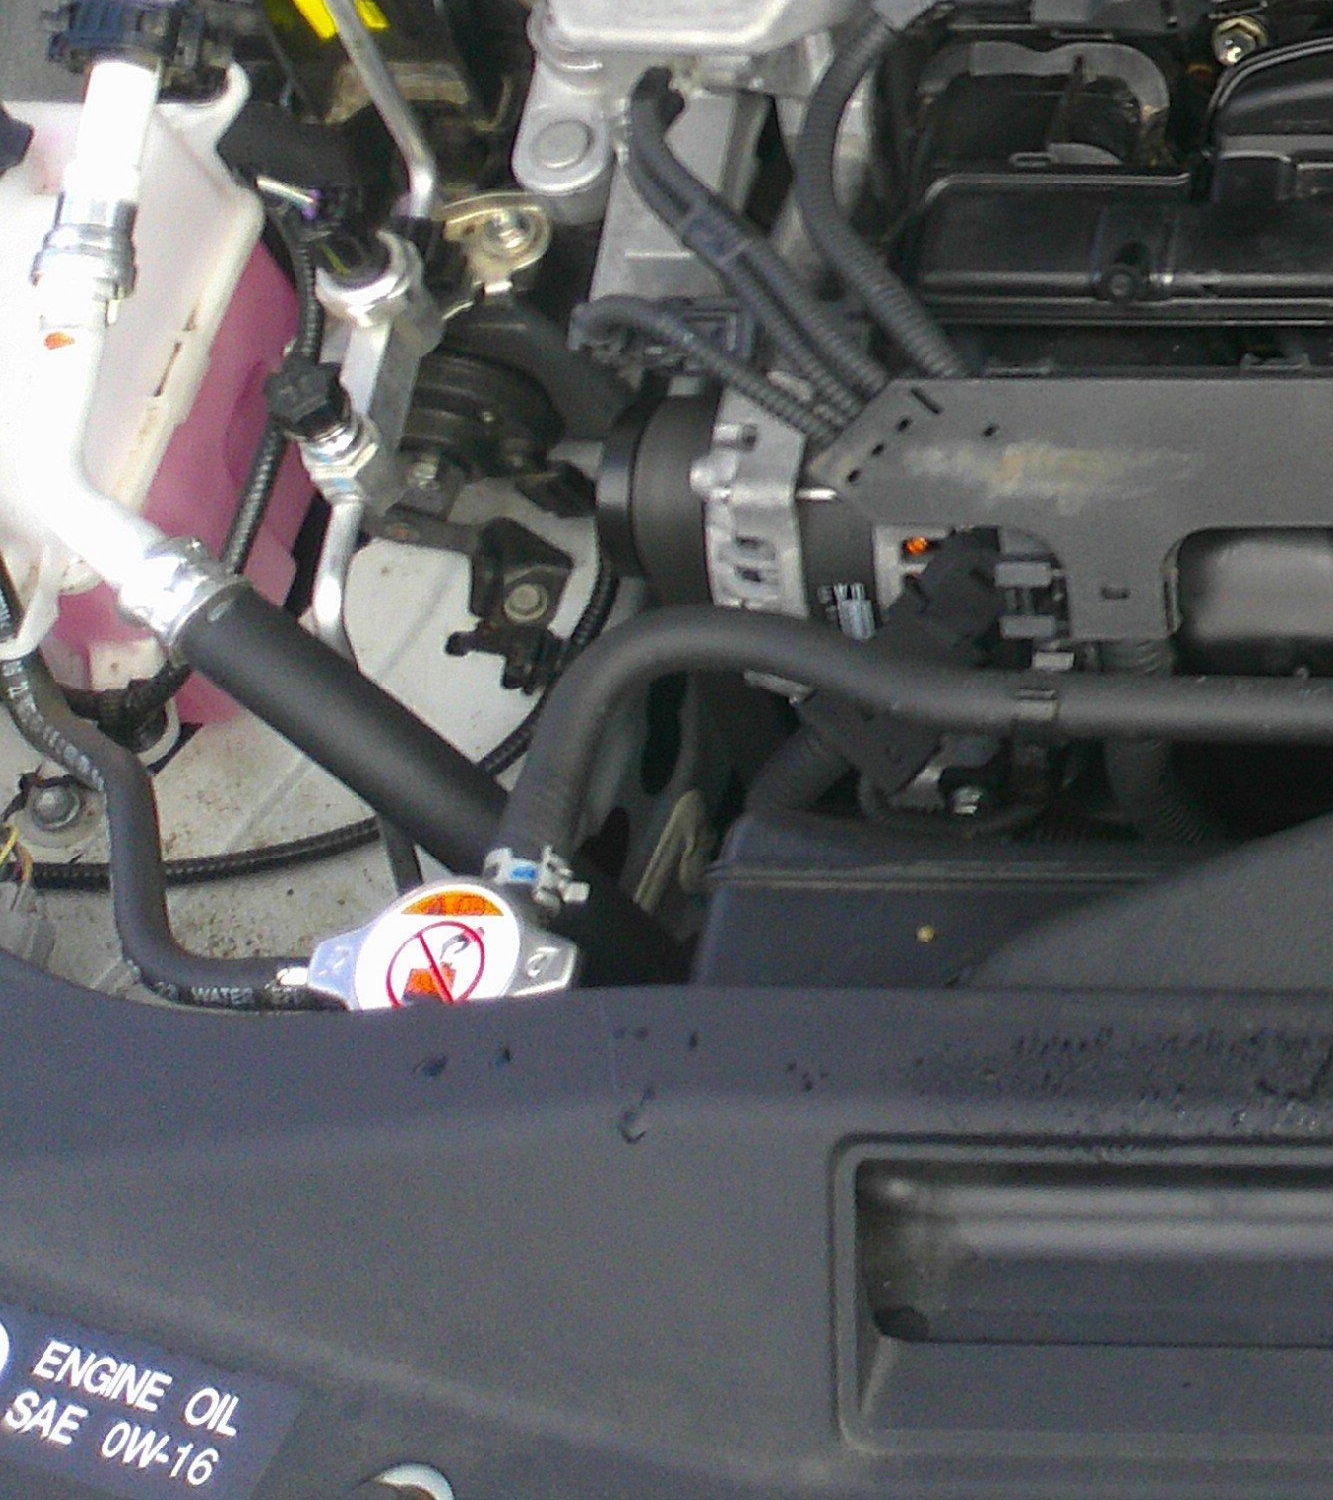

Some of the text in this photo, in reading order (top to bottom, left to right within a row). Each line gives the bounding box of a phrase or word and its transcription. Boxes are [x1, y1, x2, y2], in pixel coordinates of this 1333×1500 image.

[32, 1340, 240, 1437] ENGINE OIL
[2, 1391, 220, 1486] SAE 0W-16
